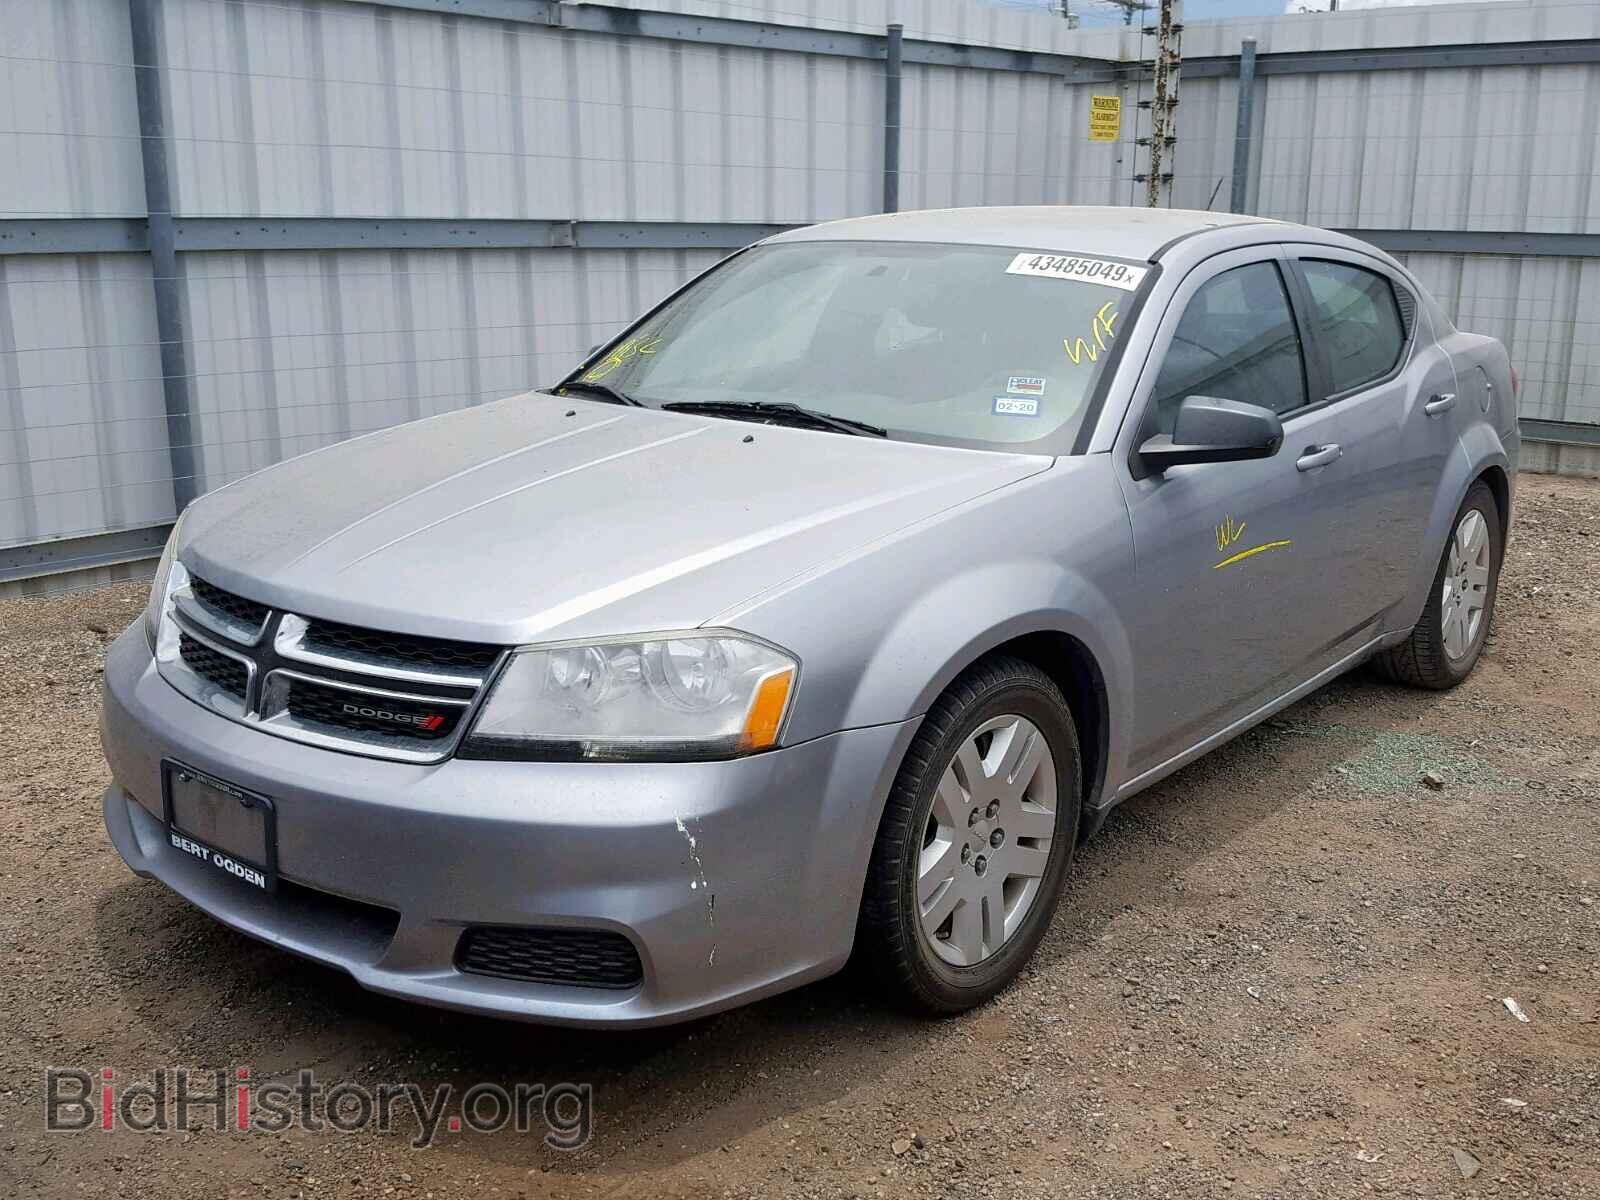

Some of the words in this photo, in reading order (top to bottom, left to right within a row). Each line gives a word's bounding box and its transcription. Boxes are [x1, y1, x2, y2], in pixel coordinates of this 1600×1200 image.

[998, 402, 1035, 412] 02-20
[343, 704, 428, 725] DODGE
[171, 834, 209, 861] BERT
[213, 854, 265, 889] OGDEN
